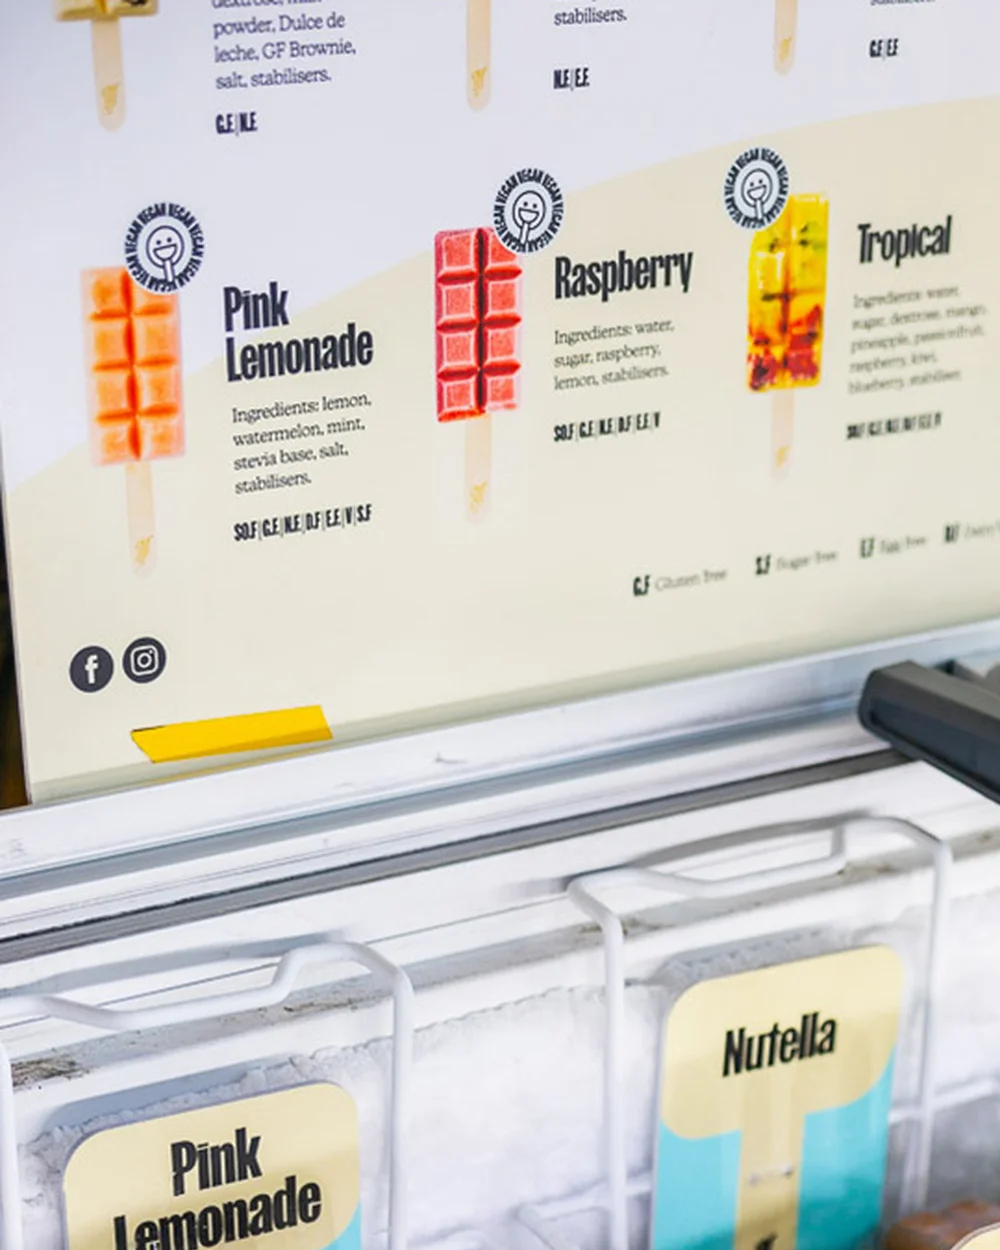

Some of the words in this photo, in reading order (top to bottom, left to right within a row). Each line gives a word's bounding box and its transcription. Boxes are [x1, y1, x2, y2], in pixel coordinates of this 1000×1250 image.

[213, 17, 276, 39] powder,
[279, 14, 323, 31] Dulce
[326, 12, 345, 28] de
[554, 7, 627, 26] stabilisers.
[214, 45, 259, 63] leche,
[262, 41, 286, 59] GF
[289, 38, 356, 58] Brownie,
[215, 72, 248, 89] salt,
[250, 68, 332, 87] stabilisers.
[857, 214, 952, 268] Tropical
[555, 250, 694, 302] Raspberry
[223, 281, 289, 332] Pink
[554, 325, 633, 346] Ingredients:
[635, 320, 674, 335] water,
[226, 322, 374, 382] Lemonade
[554, 351, 593, 369] sugar,
[596, 344, 662, 363] raspberry,
[553, 375, 599, 391] lemon,
[232, 401, 319, 425] Ingredients:
[322, 393, 372, 411] lemon,
[233, 423, 325, 446] watermelon,
[327, 417, 365, 434] mint,
[234, 453, 277, 471] stevia
[280, 449, 317, 464] base,
[319, 442, 349, 459] salt,
[235, 473, 312, 494] stabilisers.
[722, 1011, 837, 1078] Nutella
[169, 1127, 262, 1197] Pink
